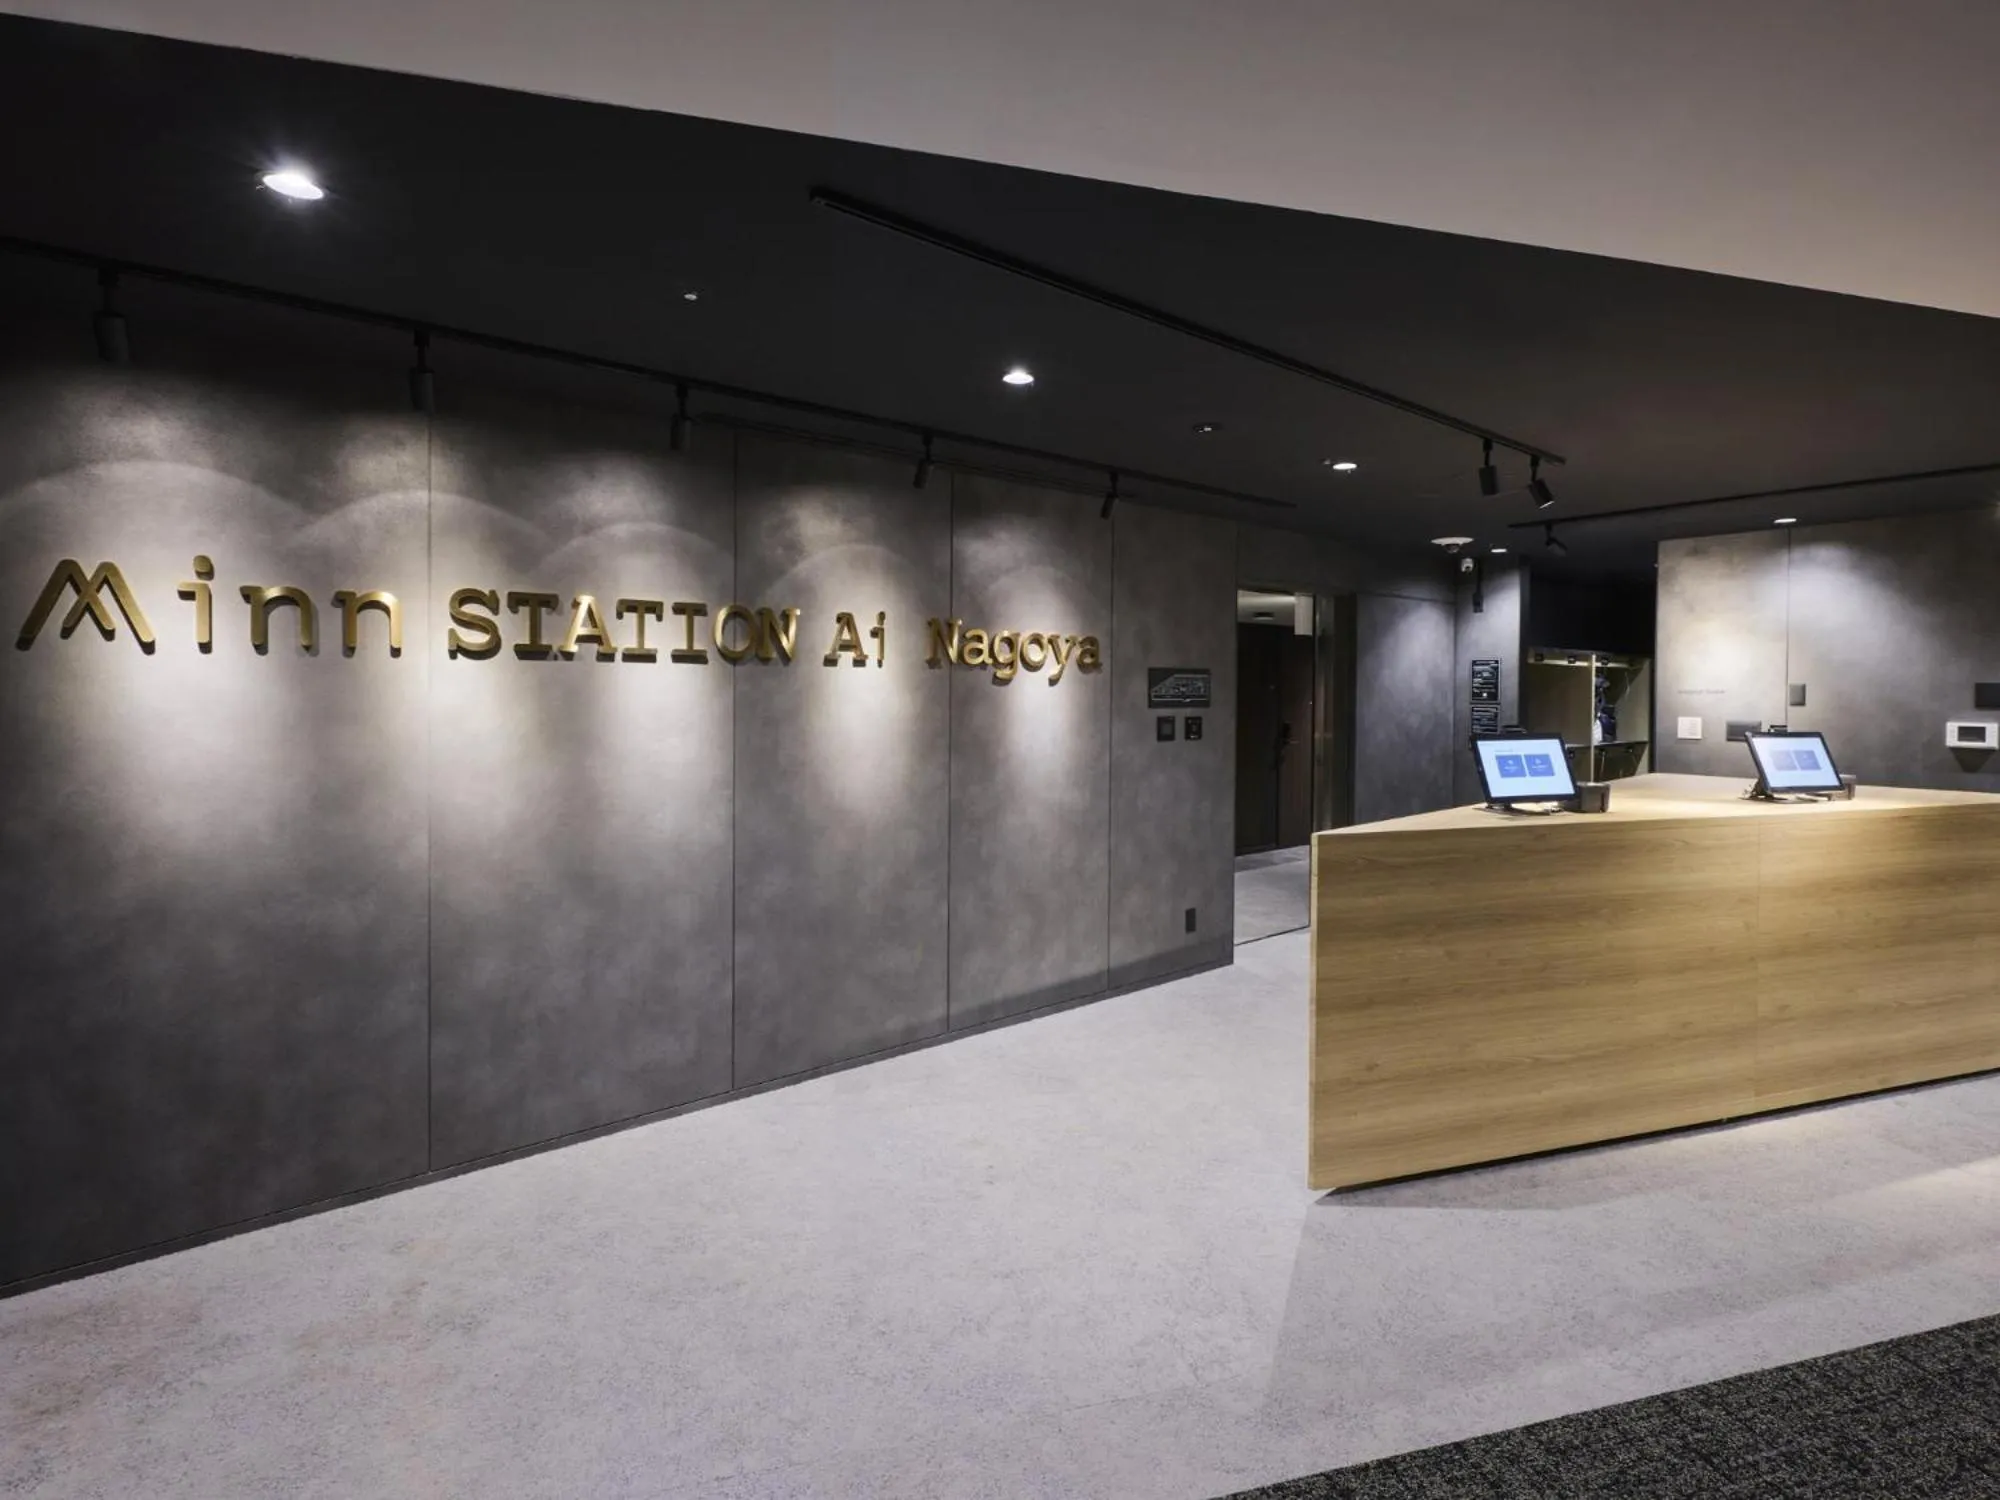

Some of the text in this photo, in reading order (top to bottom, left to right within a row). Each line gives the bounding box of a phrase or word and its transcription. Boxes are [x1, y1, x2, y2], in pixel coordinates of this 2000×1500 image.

[15, 554, 1102, 686] Minn STATION Ai Nagoya
